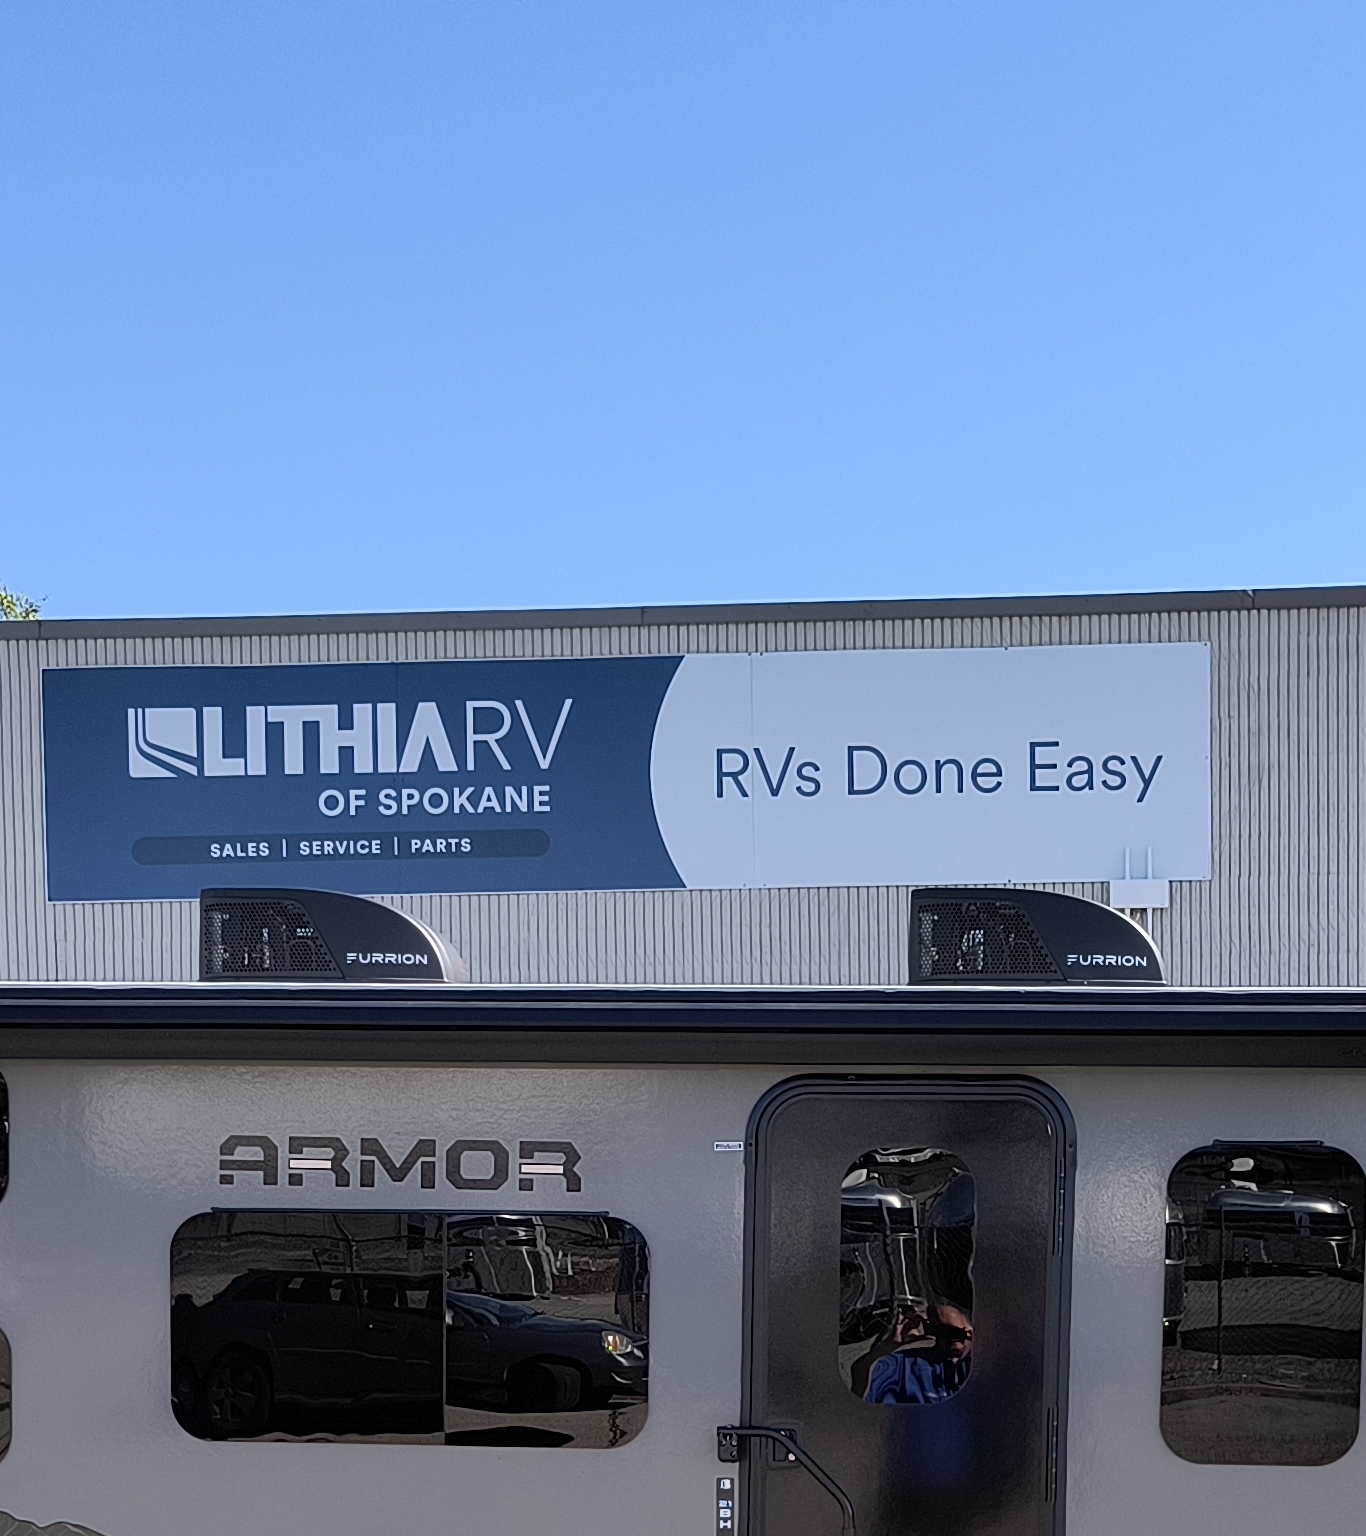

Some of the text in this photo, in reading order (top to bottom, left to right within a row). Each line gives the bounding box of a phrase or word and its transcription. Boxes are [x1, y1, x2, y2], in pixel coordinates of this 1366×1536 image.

[715, 740, 1164, 804] RVs Done Easy
[317, 784, 552, 817] OF SPOKANE
[209, 837, 472, 859] SALES SERVICE PARTS
[346, 952, 428, 966] FURRION
[1066, 954, 1147, 967] FURRION
[219, 1134, 582, 1193] ARMOR
